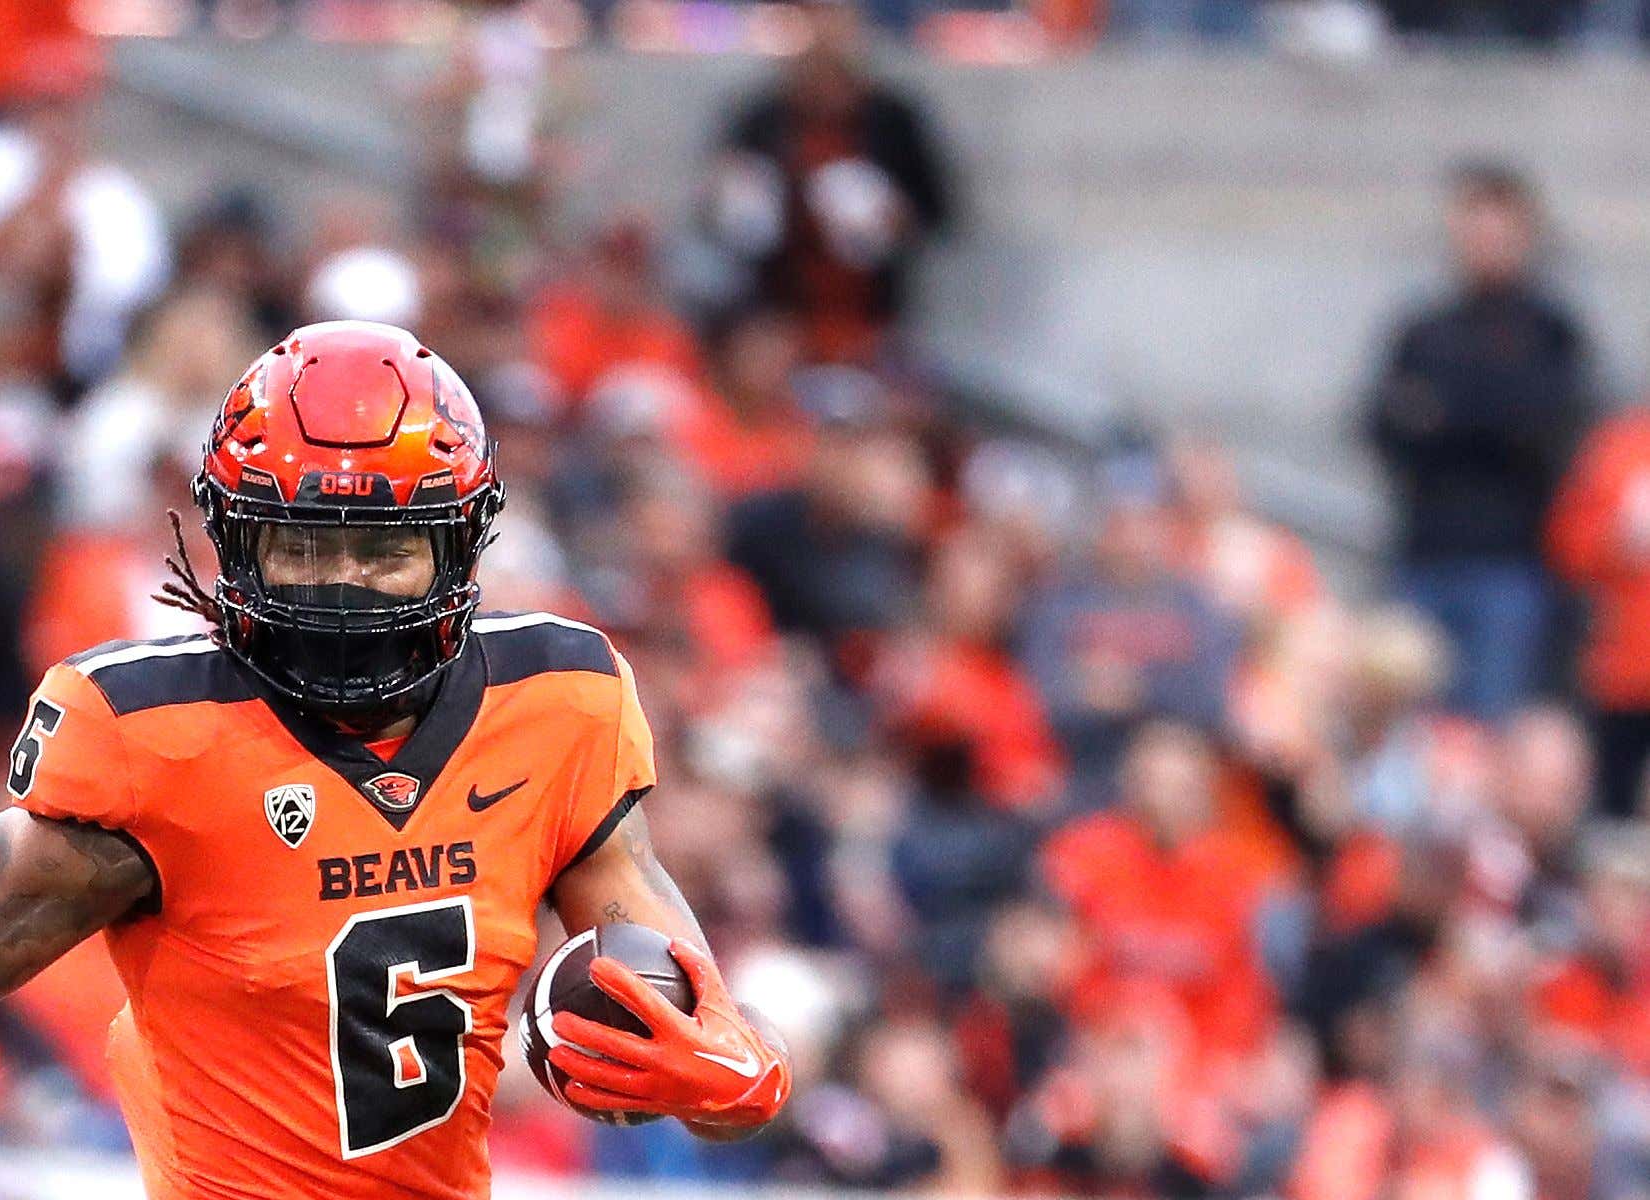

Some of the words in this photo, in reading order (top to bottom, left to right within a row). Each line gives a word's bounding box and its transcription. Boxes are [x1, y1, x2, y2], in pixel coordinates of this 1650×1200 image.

[320, 474, 374, 496] OSU
[7, 695, 66, 800] 6
[267, 787, 312, 824] PAC
[280, 810, 306, 836] 12
[317, 841, 477, 901] BEAVS
[324, 895, 476, 1161] 6
